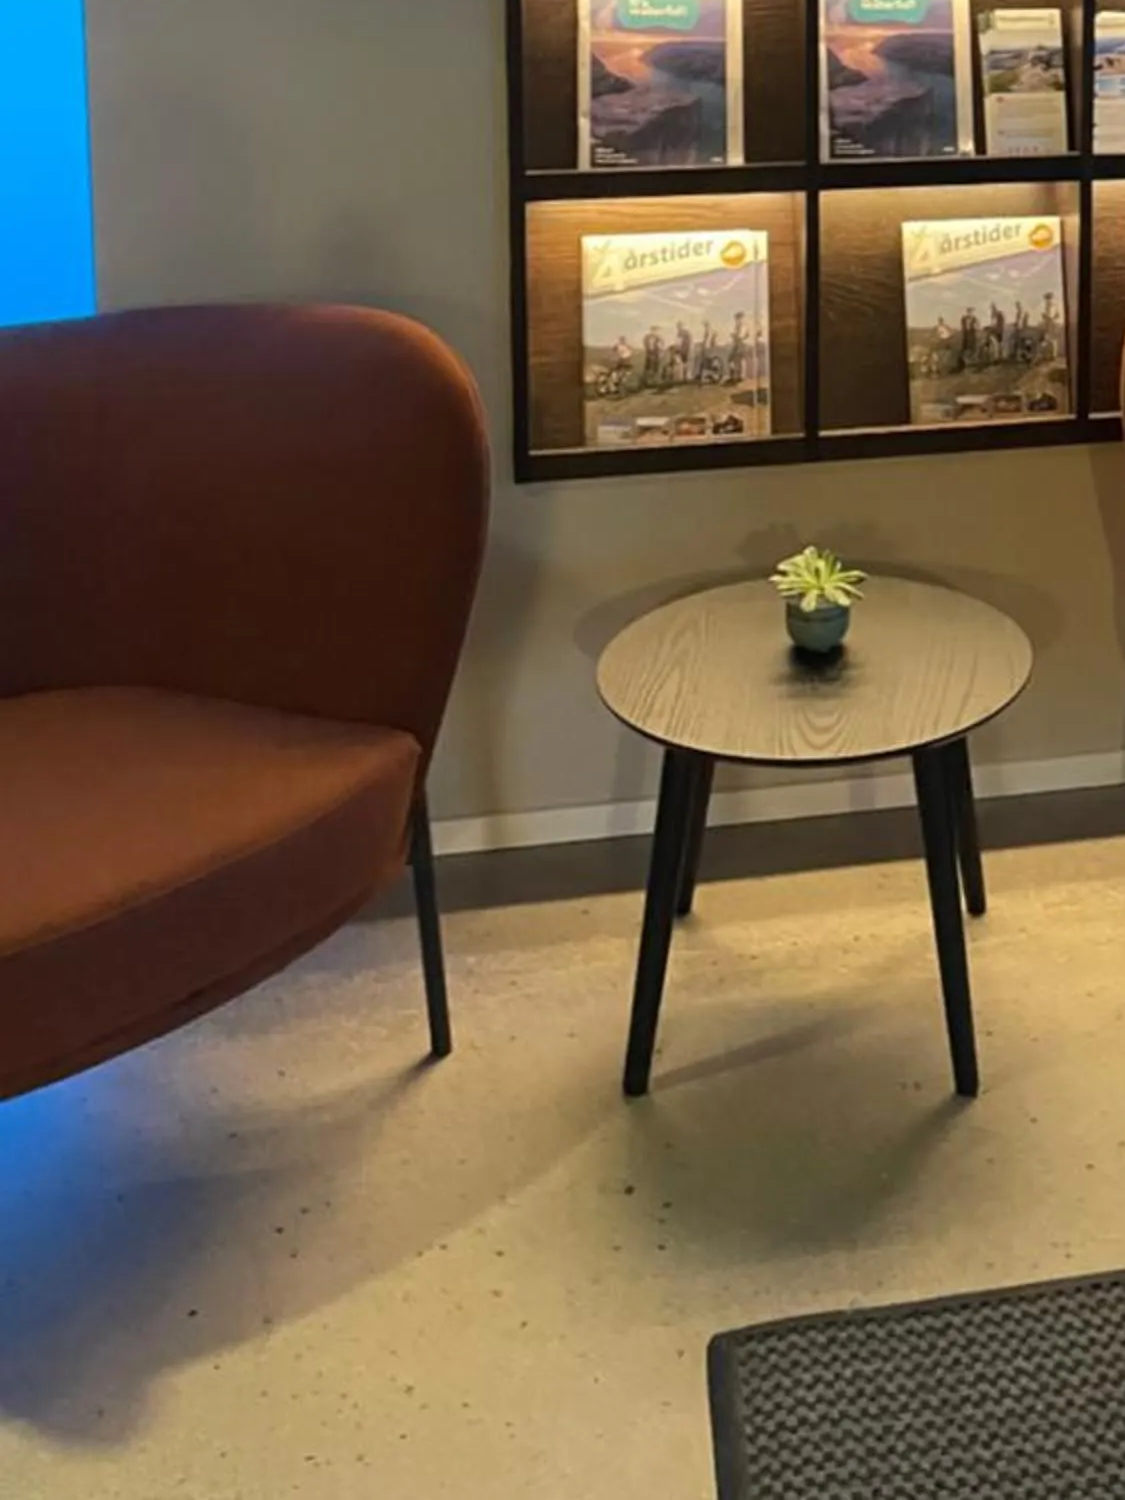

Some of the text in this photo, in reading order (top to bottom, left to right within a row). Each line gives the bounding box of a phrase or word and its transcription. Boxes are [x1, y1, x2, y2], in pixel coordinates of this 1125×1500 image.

[940, 223, 1022, 254] årstider
[591, 239, 714, 290] 4 årstider
